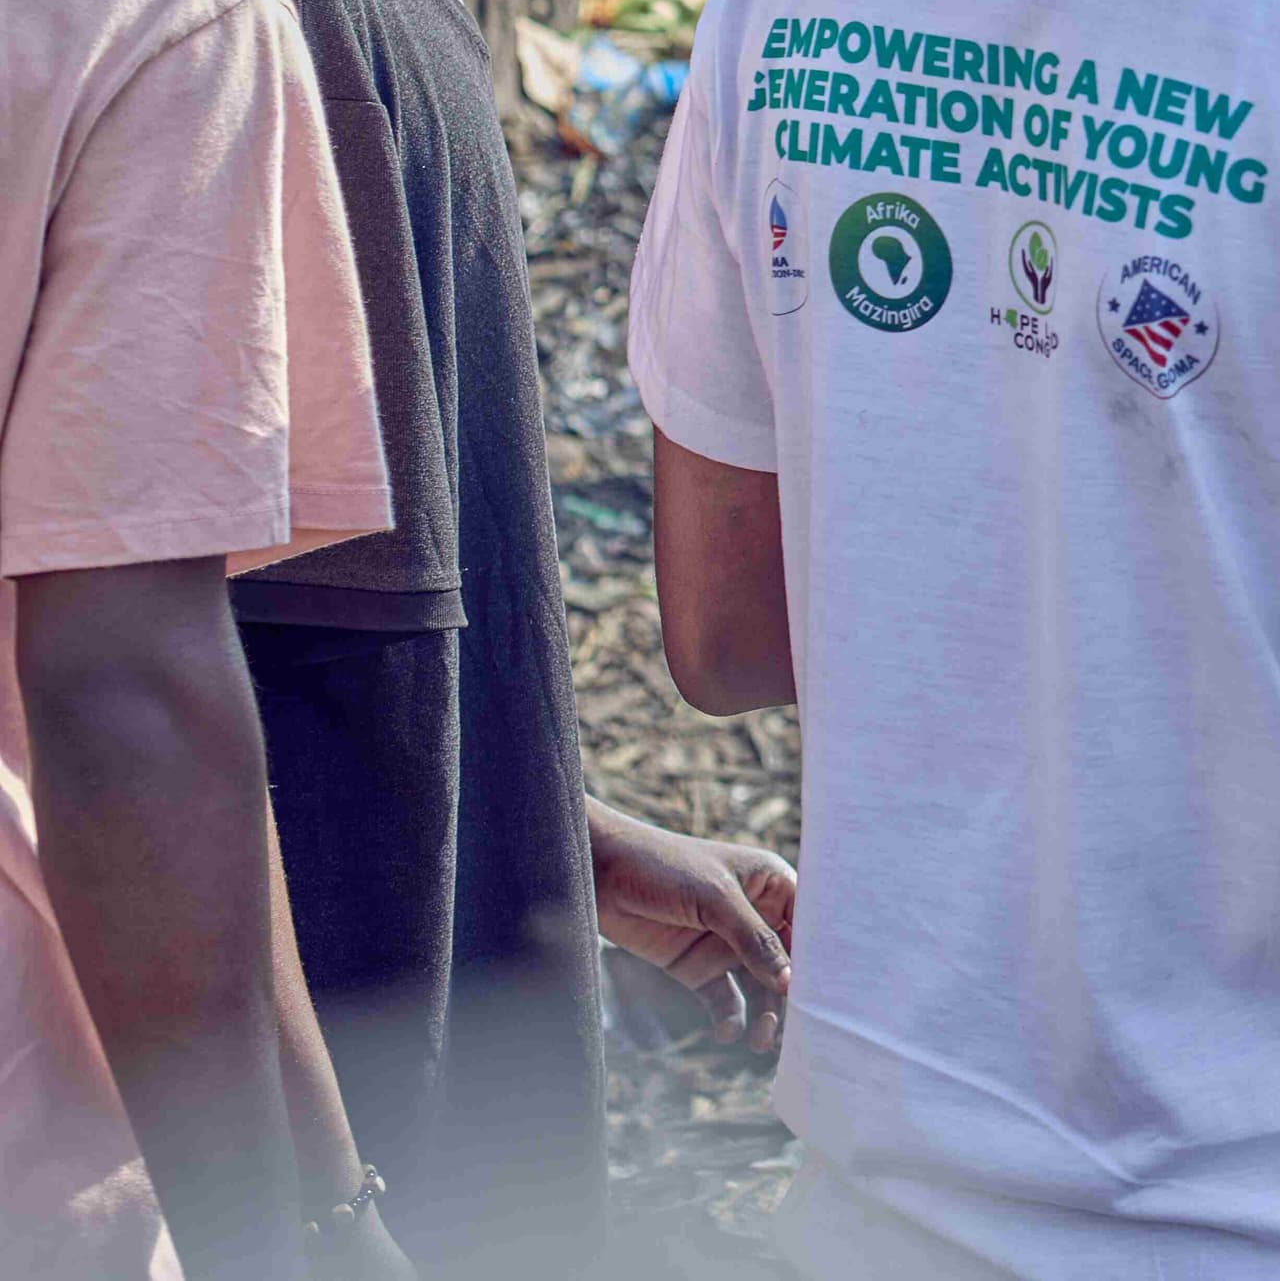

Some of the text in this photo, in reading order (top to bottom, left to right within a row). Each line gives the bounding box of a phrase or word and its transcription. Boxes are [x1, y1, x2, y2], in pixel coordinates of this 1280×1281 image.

[762, 17, 1254, 140] EMPOWERING A NEW
[775, 119, 1196, 239] CLIMATE ACTIVISTS
[1024, 104, 1072, 151] OF
[1082, 115, 1268, 204] YOUNG
[866, 201, 920, 229] Afrika
[845, 286, 934, 328] Mazingira
[1120, 255, 1201, 305] AMERICAN
